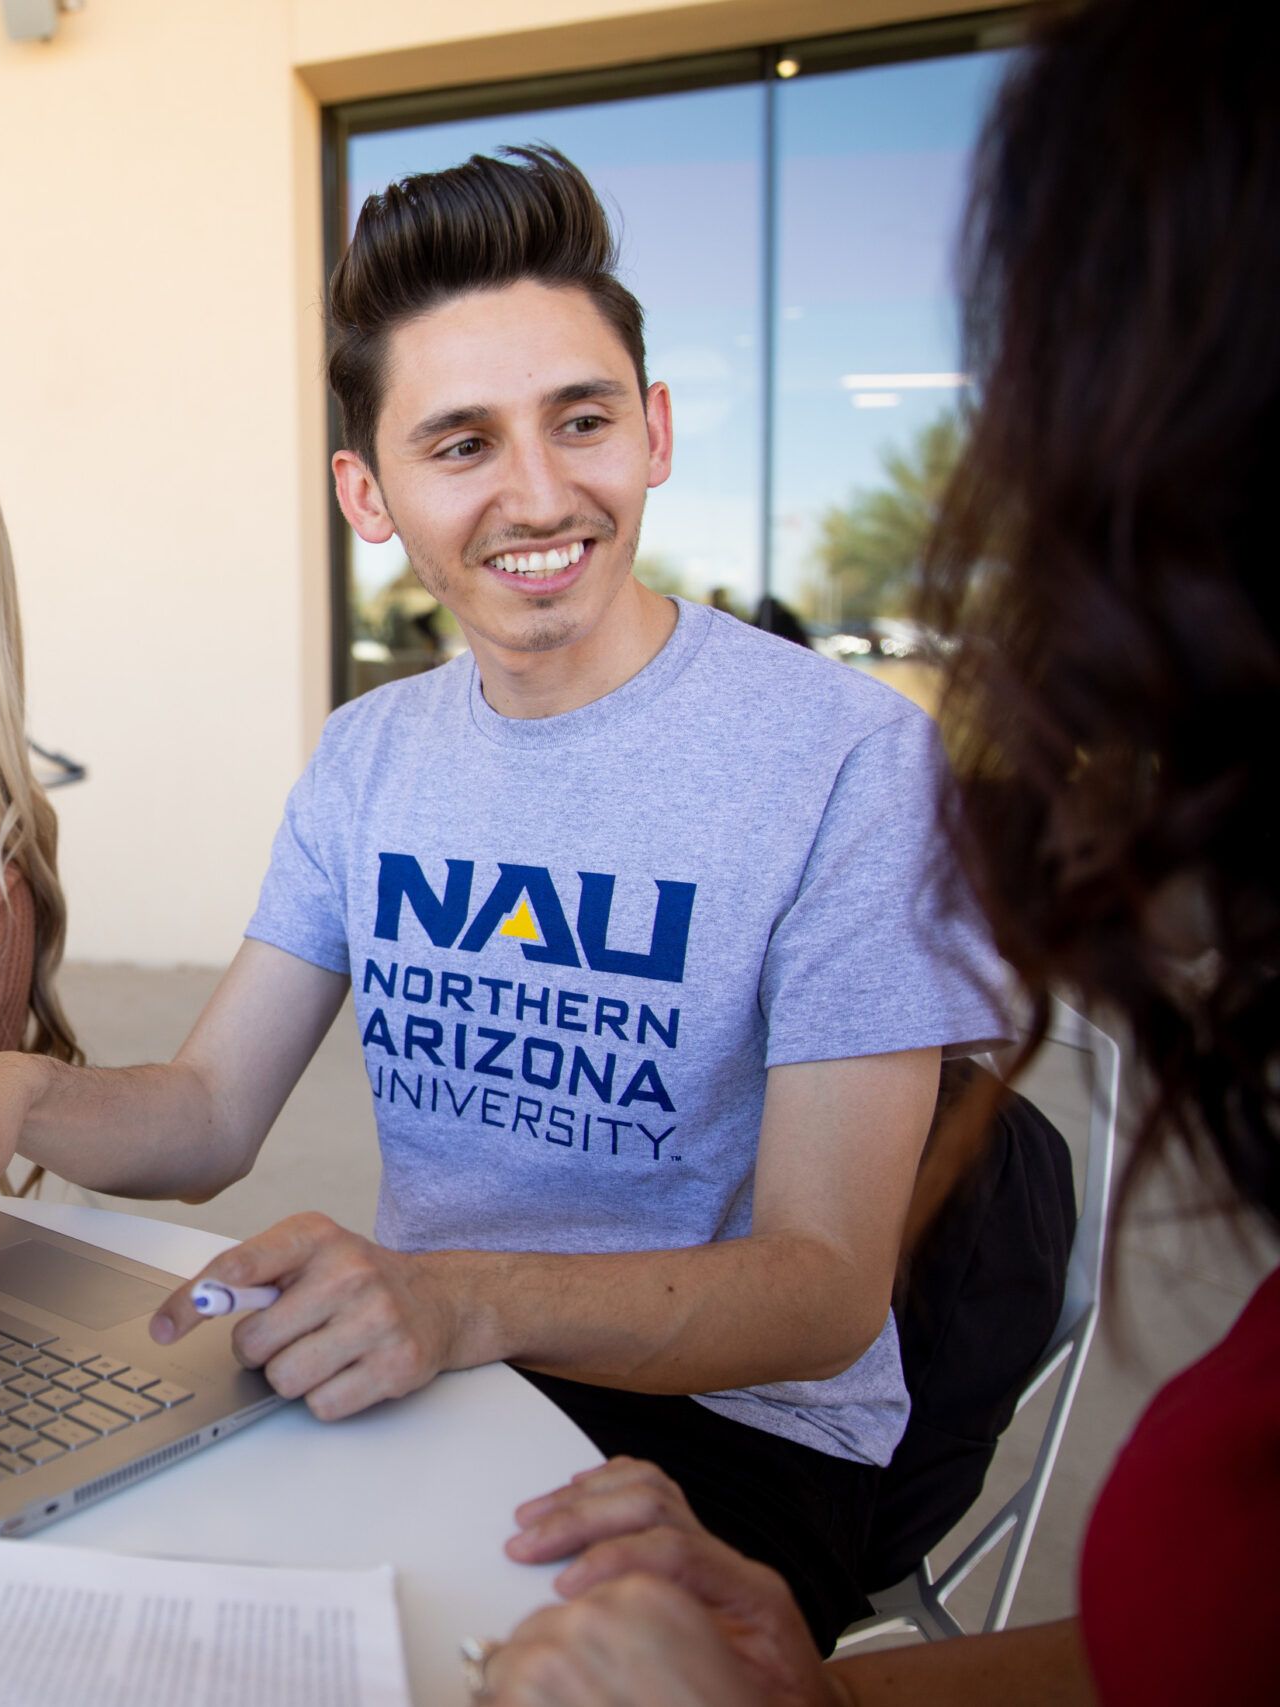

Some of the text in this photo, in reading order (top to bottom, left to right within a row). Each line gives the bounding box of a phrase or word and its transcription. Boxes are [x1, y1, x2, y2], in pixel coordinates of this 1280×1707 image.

[373, 852, 697, 983] NAU
[363, 959, 680, 1048] NORTHERN
[362, 1007, 677, 1112] ARIZONA
[365, 1059, 676, 1160] UNIVERSITY
